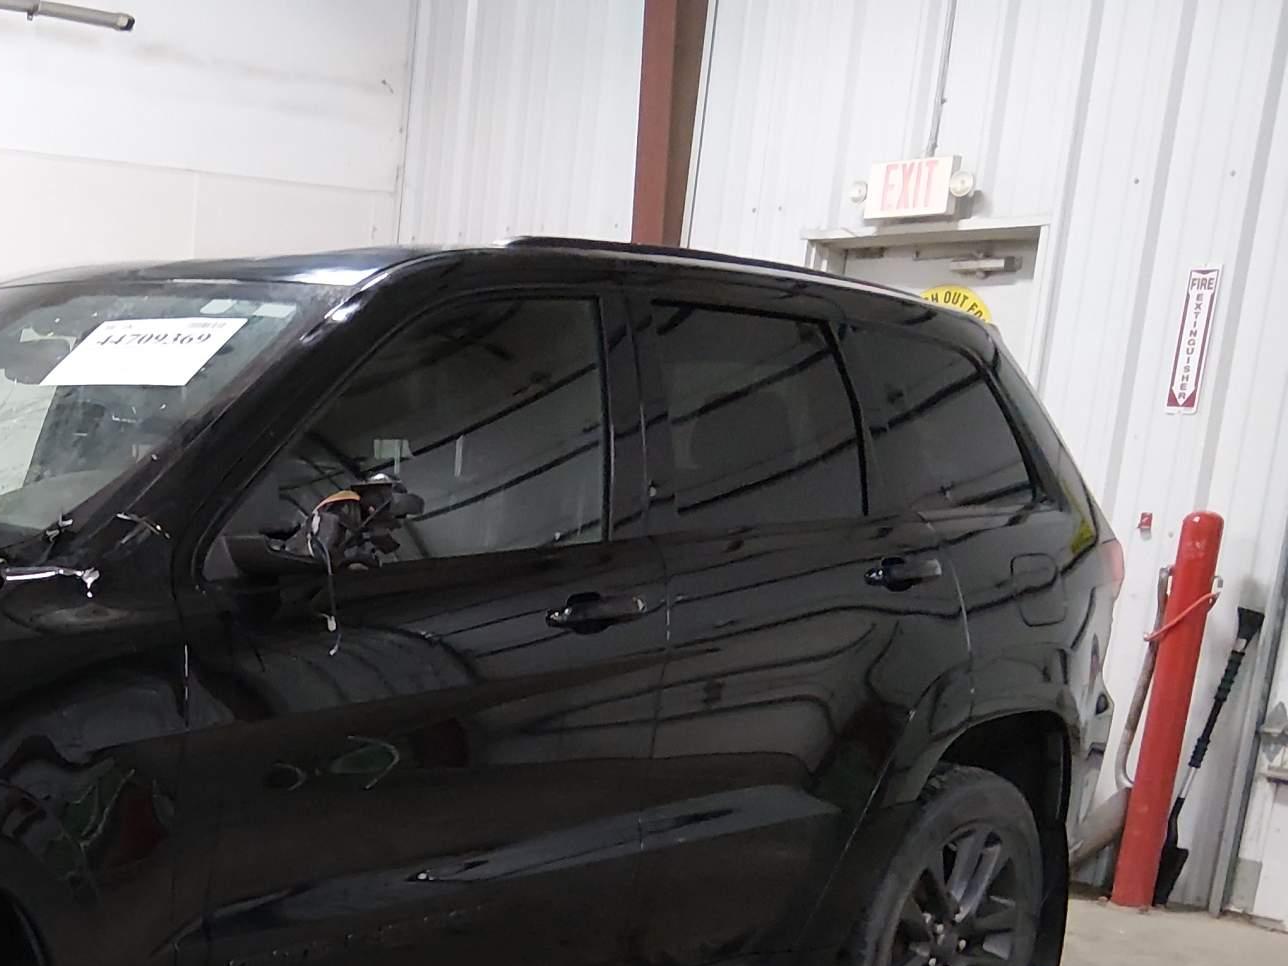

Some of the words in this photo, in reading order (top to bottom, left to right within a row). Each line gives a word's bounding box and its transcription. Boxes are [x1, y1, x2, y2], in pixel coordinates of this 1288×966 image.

[880, 160, 939, 212] EXIT
[943, 290, 969, 308] OUT
[1190, 277, 1215, 291] FIRE
[1177, 293, 1204, 400] EXTINGUISHER
